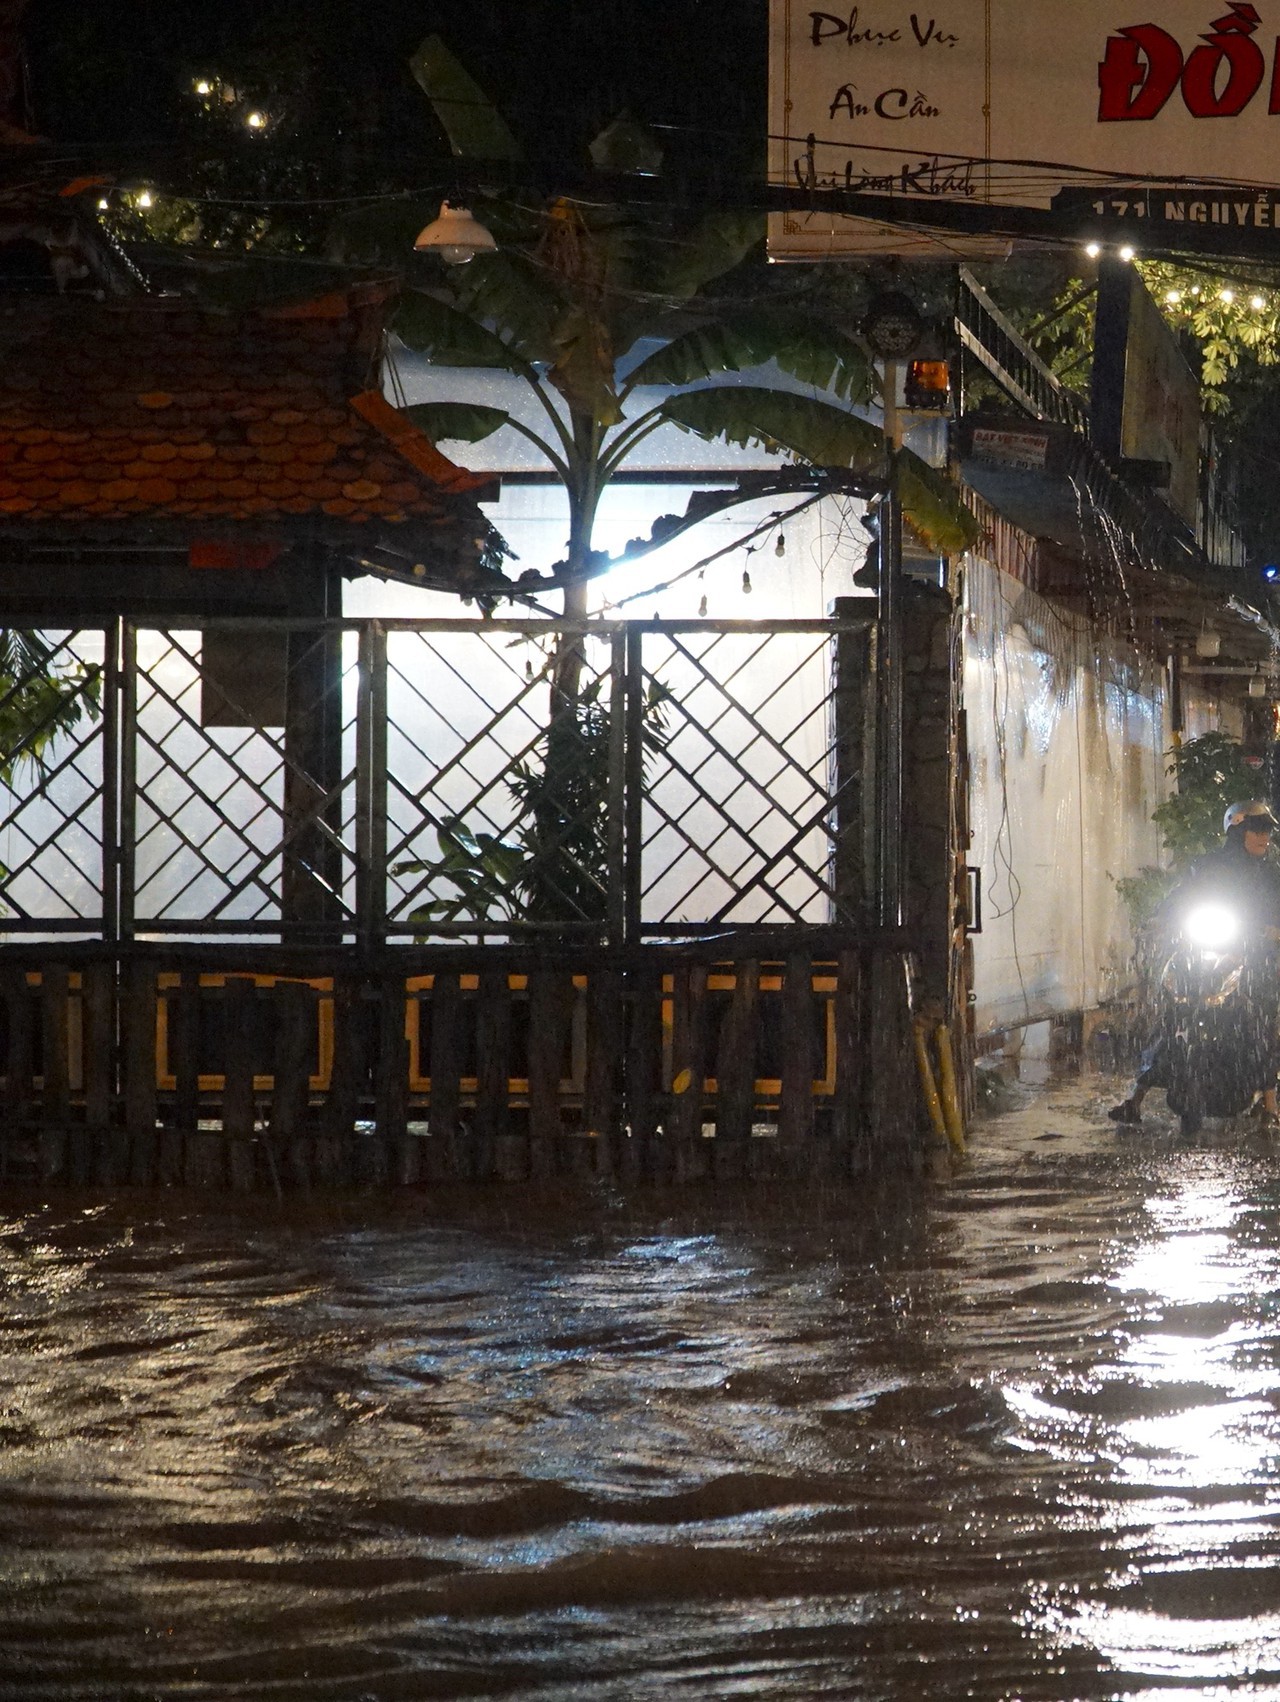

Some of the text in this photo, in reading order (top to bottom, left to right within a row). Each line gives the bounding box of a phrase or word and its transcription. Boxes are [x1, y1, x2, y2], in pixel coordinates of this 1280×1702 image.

[808, 6, 960, 47] Phục Vụ
[829, 83, 941, 120] Ân Cần
[901, 155, 977, 196] Khách
[1092, 200, 1145, 218] 171
